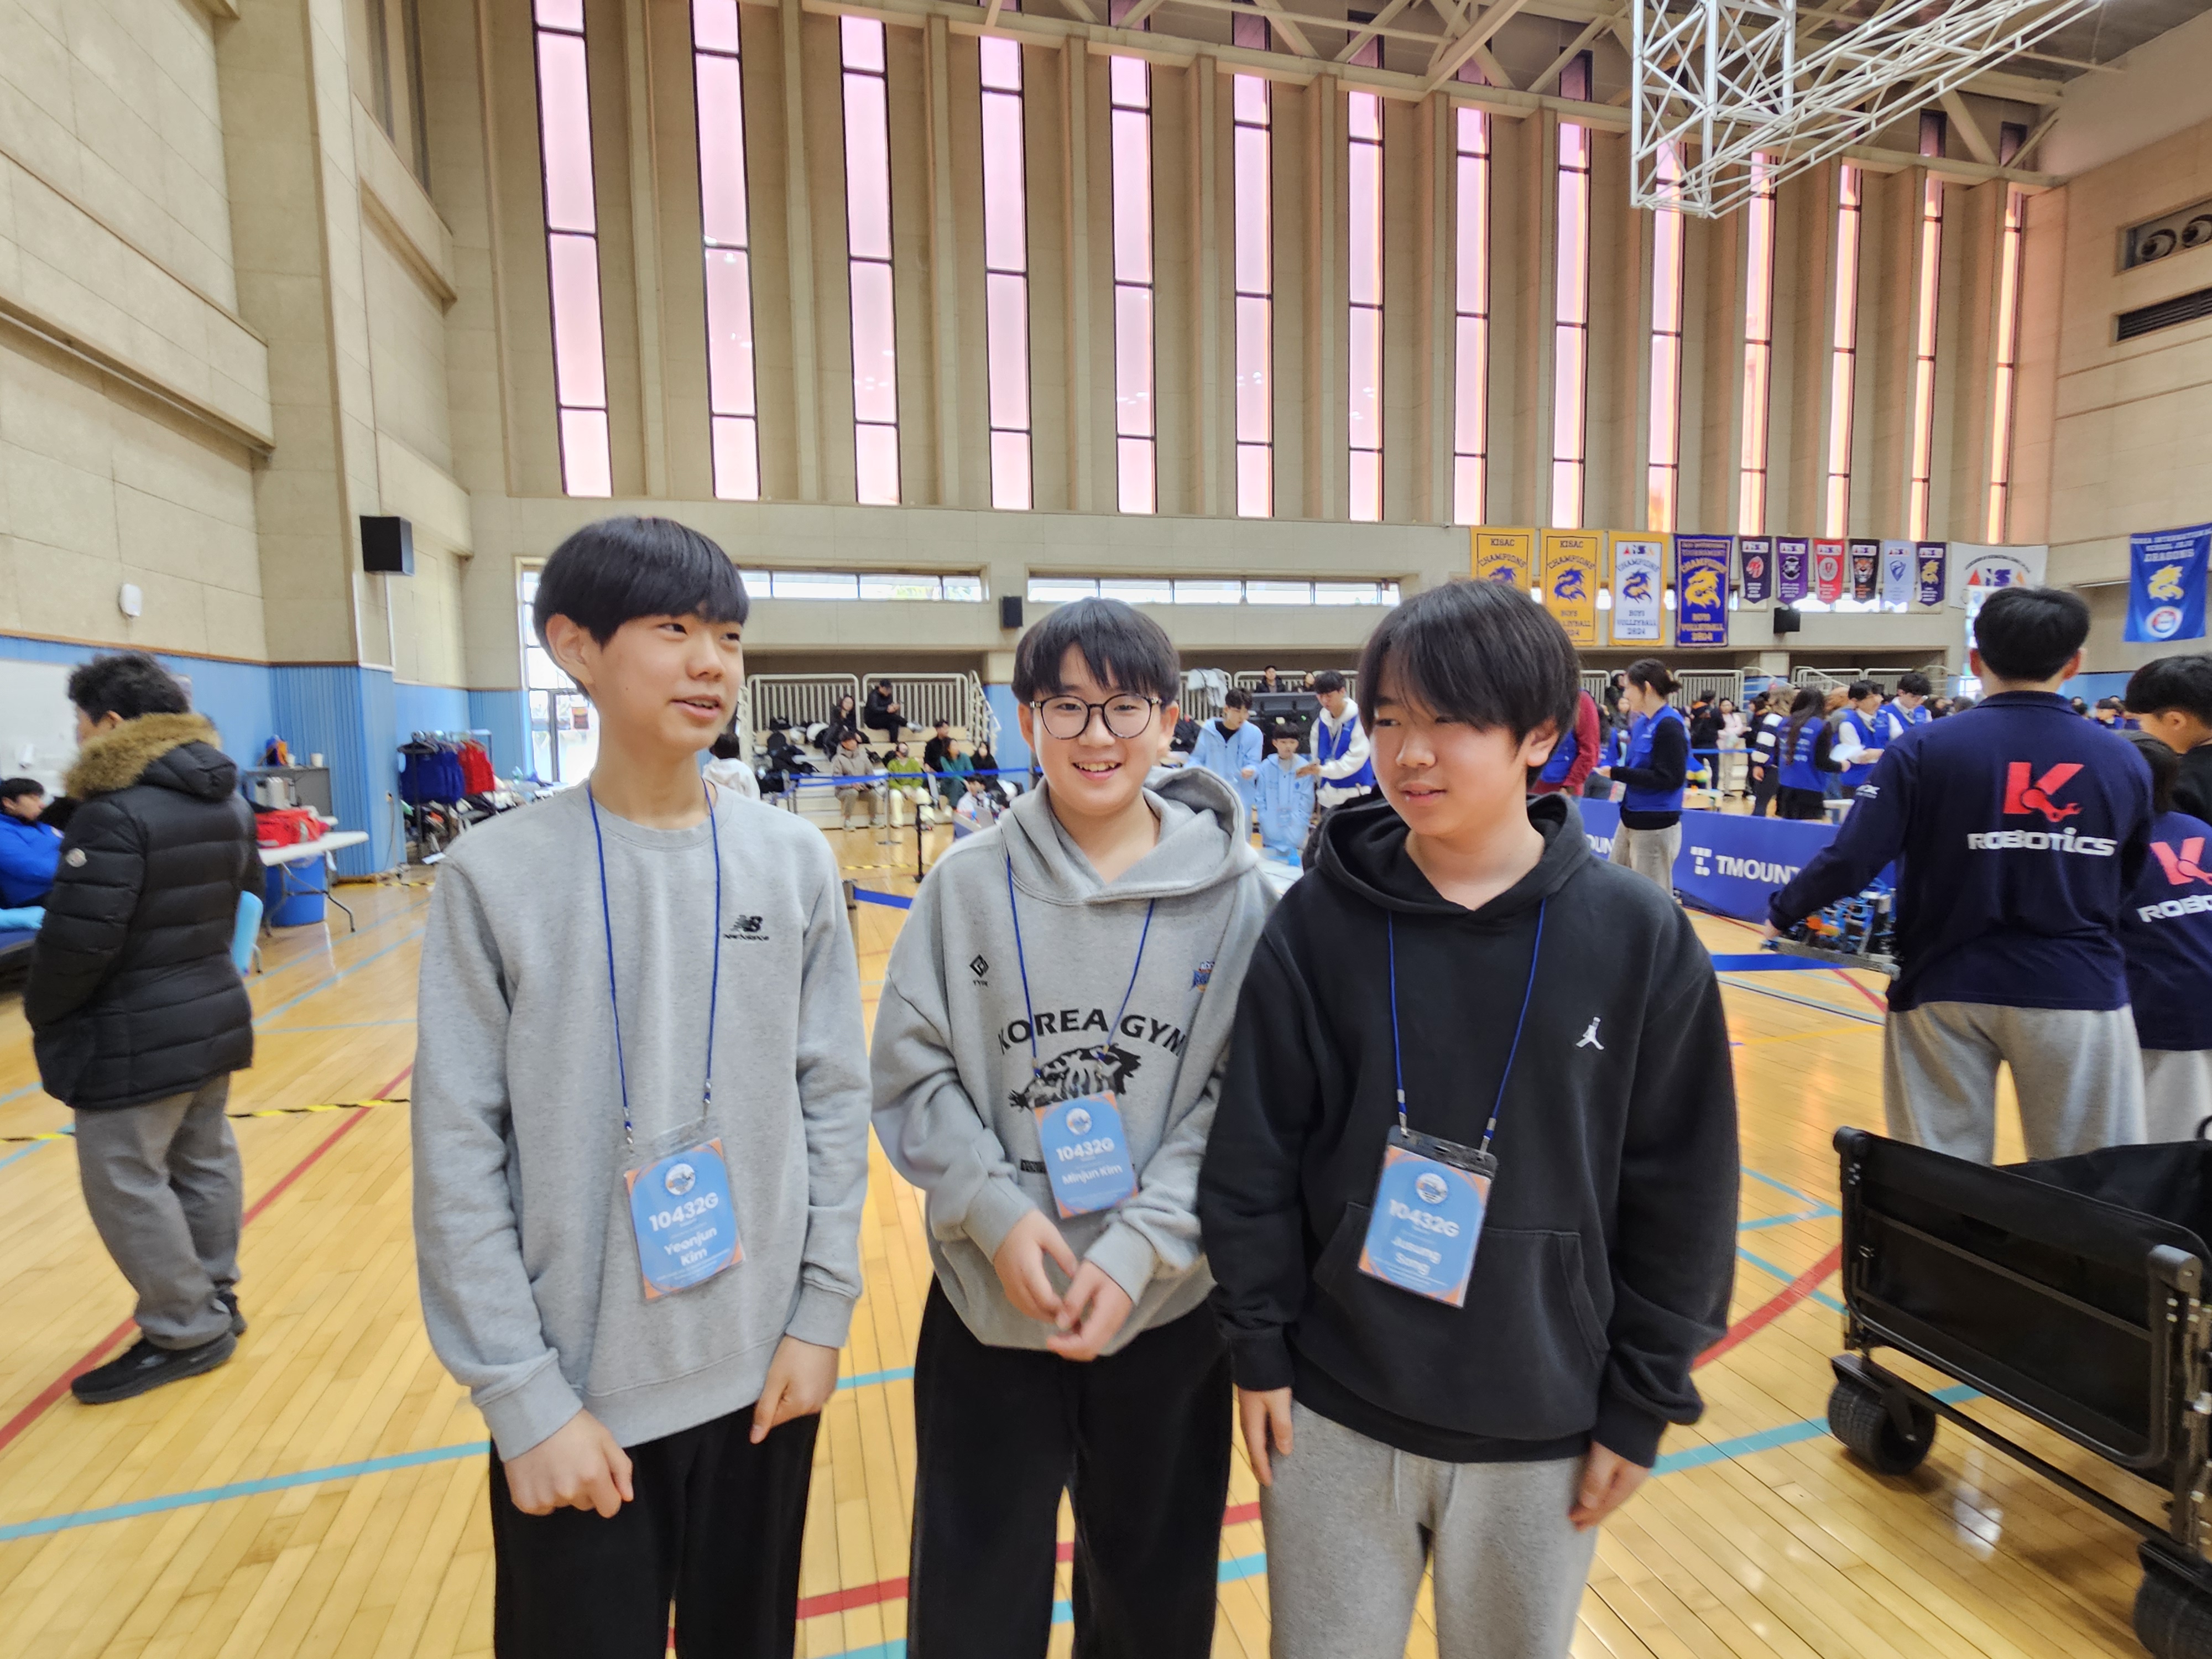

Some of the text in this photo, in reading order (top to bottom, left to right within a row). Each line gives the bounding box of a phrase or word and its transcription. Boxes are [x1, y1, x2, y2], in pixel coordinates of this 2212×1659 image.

[1478, 554, 1526, 568] CHAMPIONS
[1548, 555, 1595, 569] CHAMPIONS
[2136, 894, 2212, 923] ROB
[998, 1009, 1109, 1055] KOREA
[649, 1192, 719, 1232] 10432G
[680, 1248, 707, 1266] Kim
